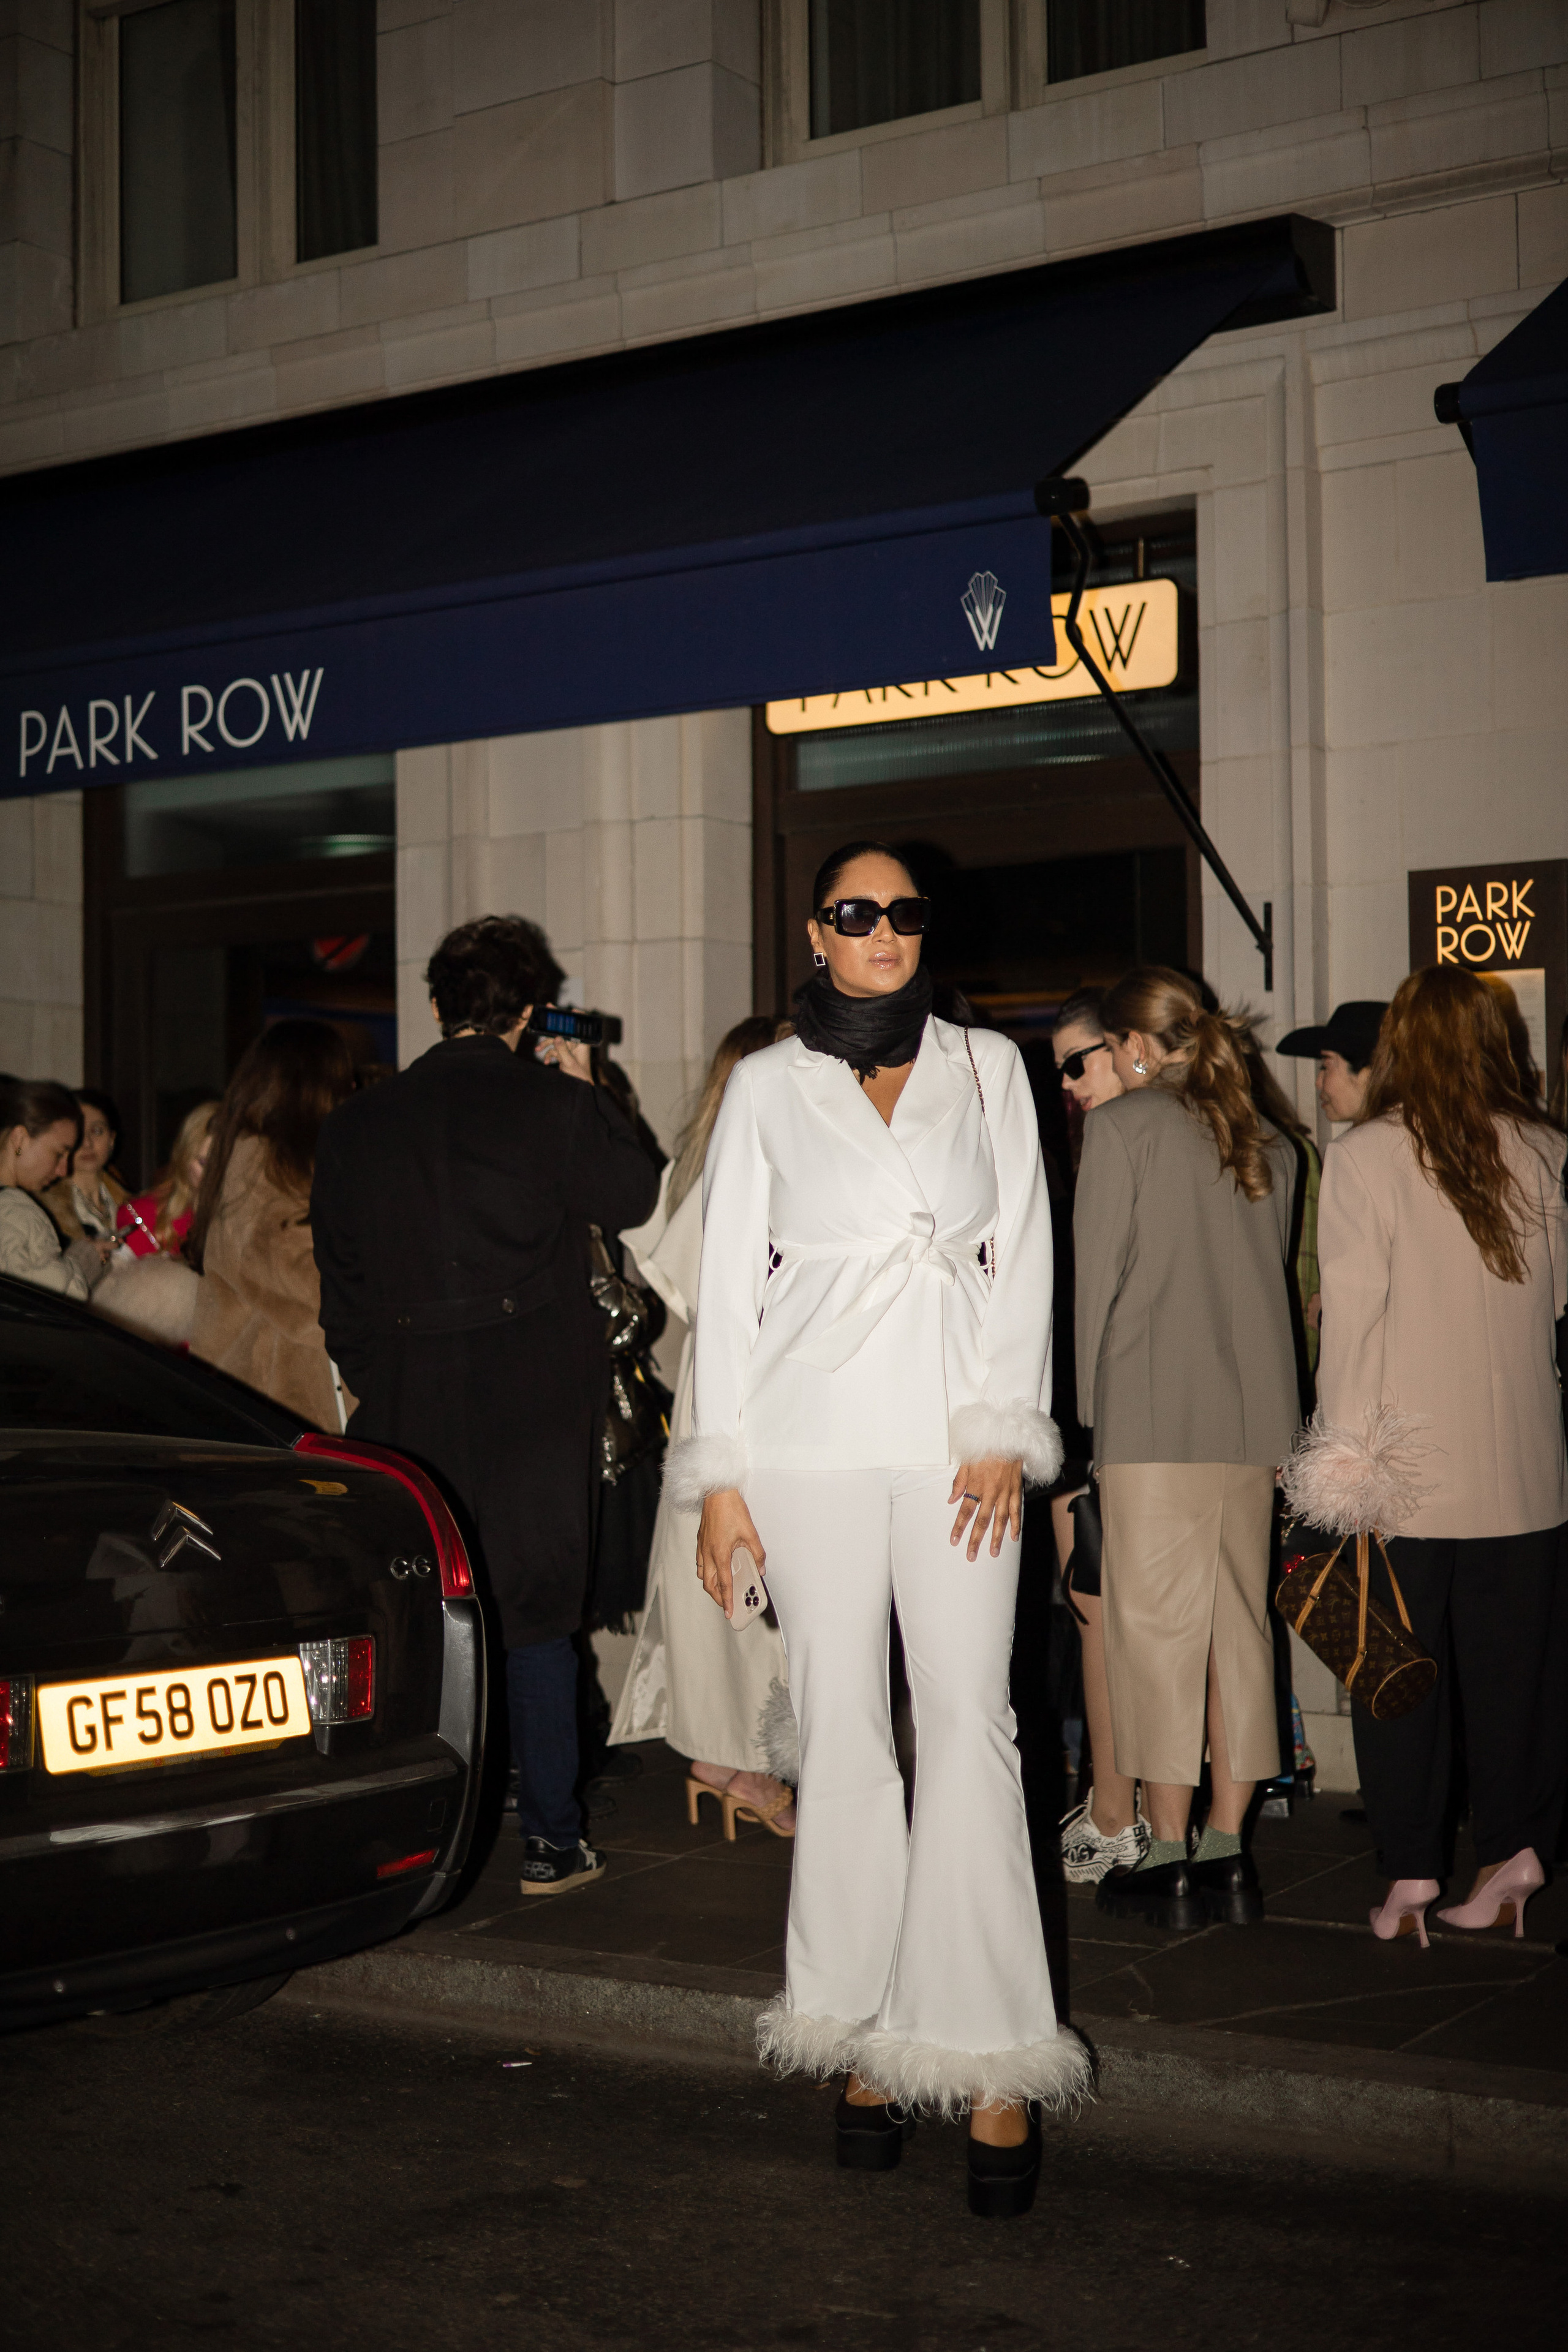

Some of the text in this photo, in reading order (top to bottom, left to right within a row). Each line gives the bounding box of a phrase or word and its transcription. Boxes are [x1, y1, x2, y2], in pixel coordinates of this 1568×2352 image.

[20, 667, 324, 777] PARK ROW
[1436, 878, 1536, 924] PARK
[1436, 920, 1531, 965] ROW
[390, 1555, 431, 1580] C6
[66, 1683, 194, 1756] GF58
